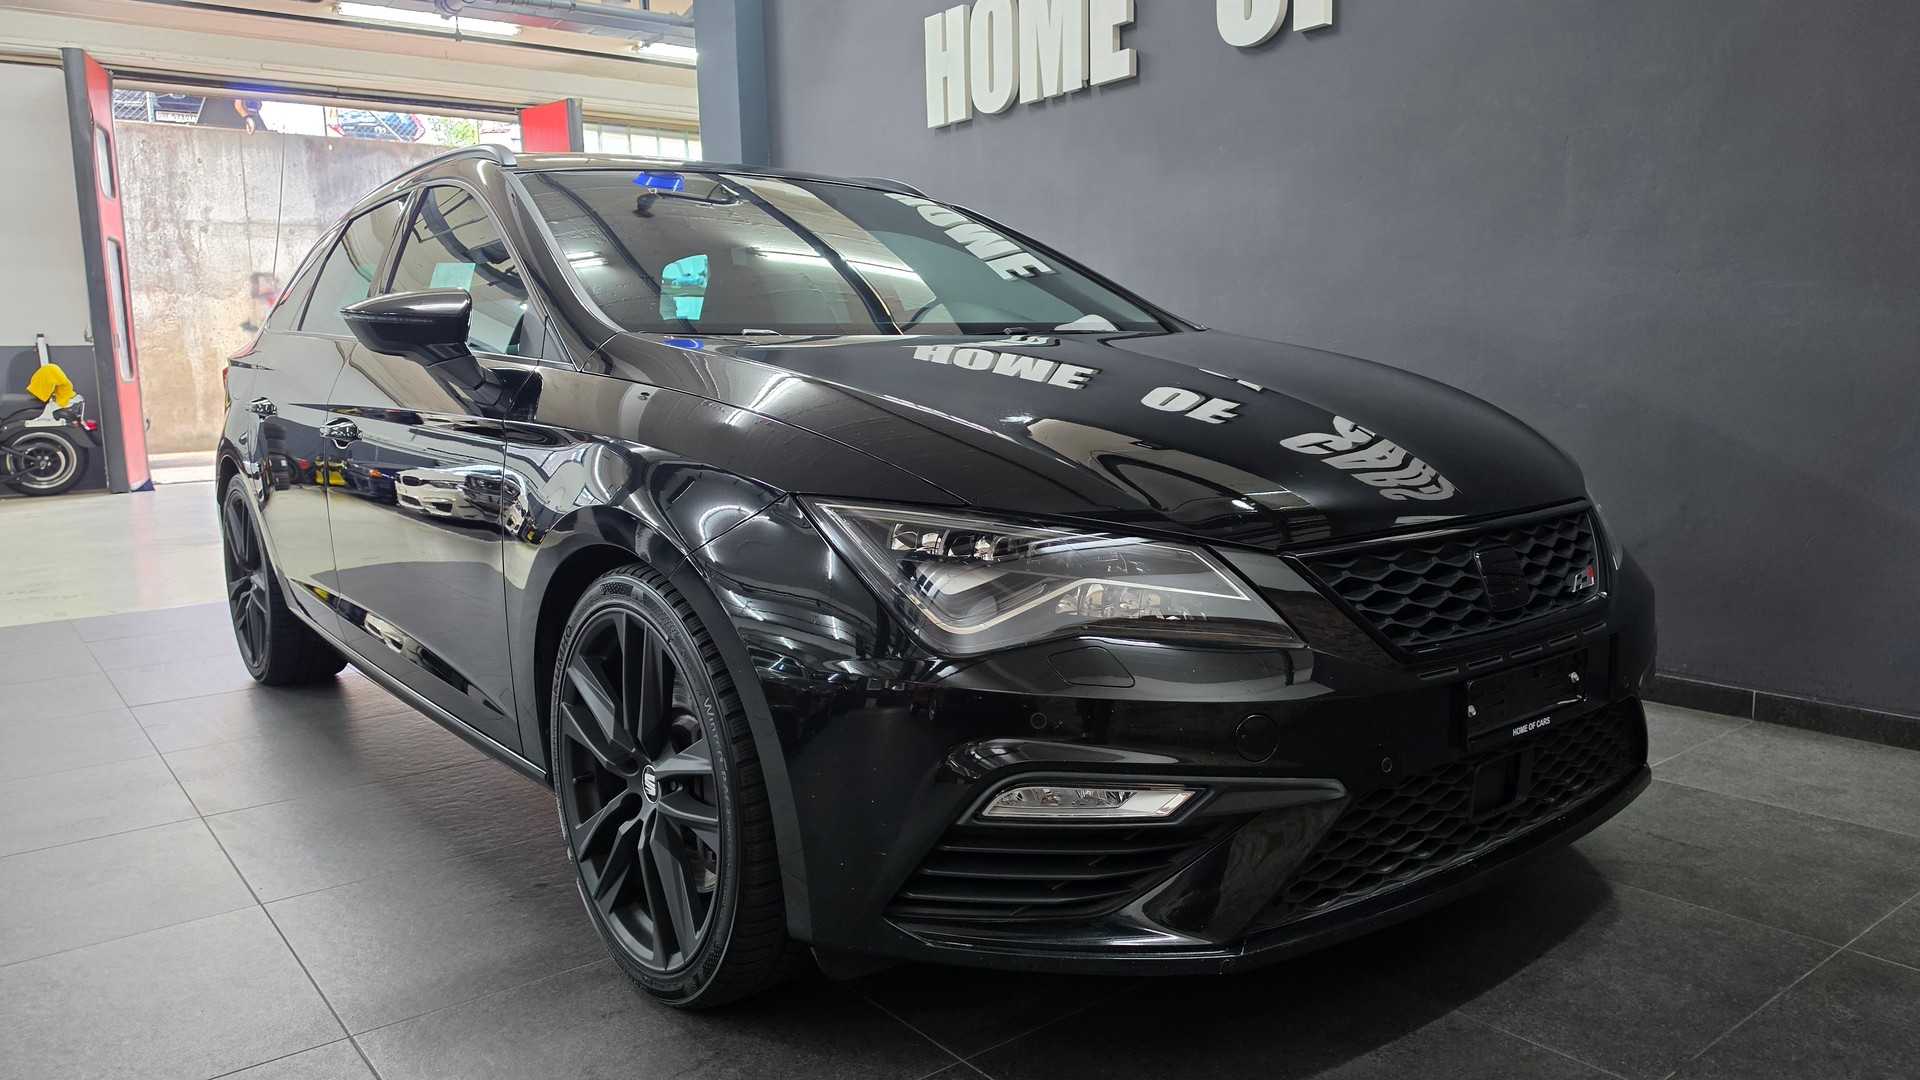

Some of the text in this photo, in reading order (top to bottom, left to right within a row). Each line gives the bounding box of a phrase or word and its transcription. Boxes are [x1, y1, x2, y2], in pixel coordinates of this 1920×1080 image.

[924, 0, 1139, 129] HOME
[553, 625, 573, 696] KUMHO
[1512, 716, 1550, 736] HOME OF CARS
